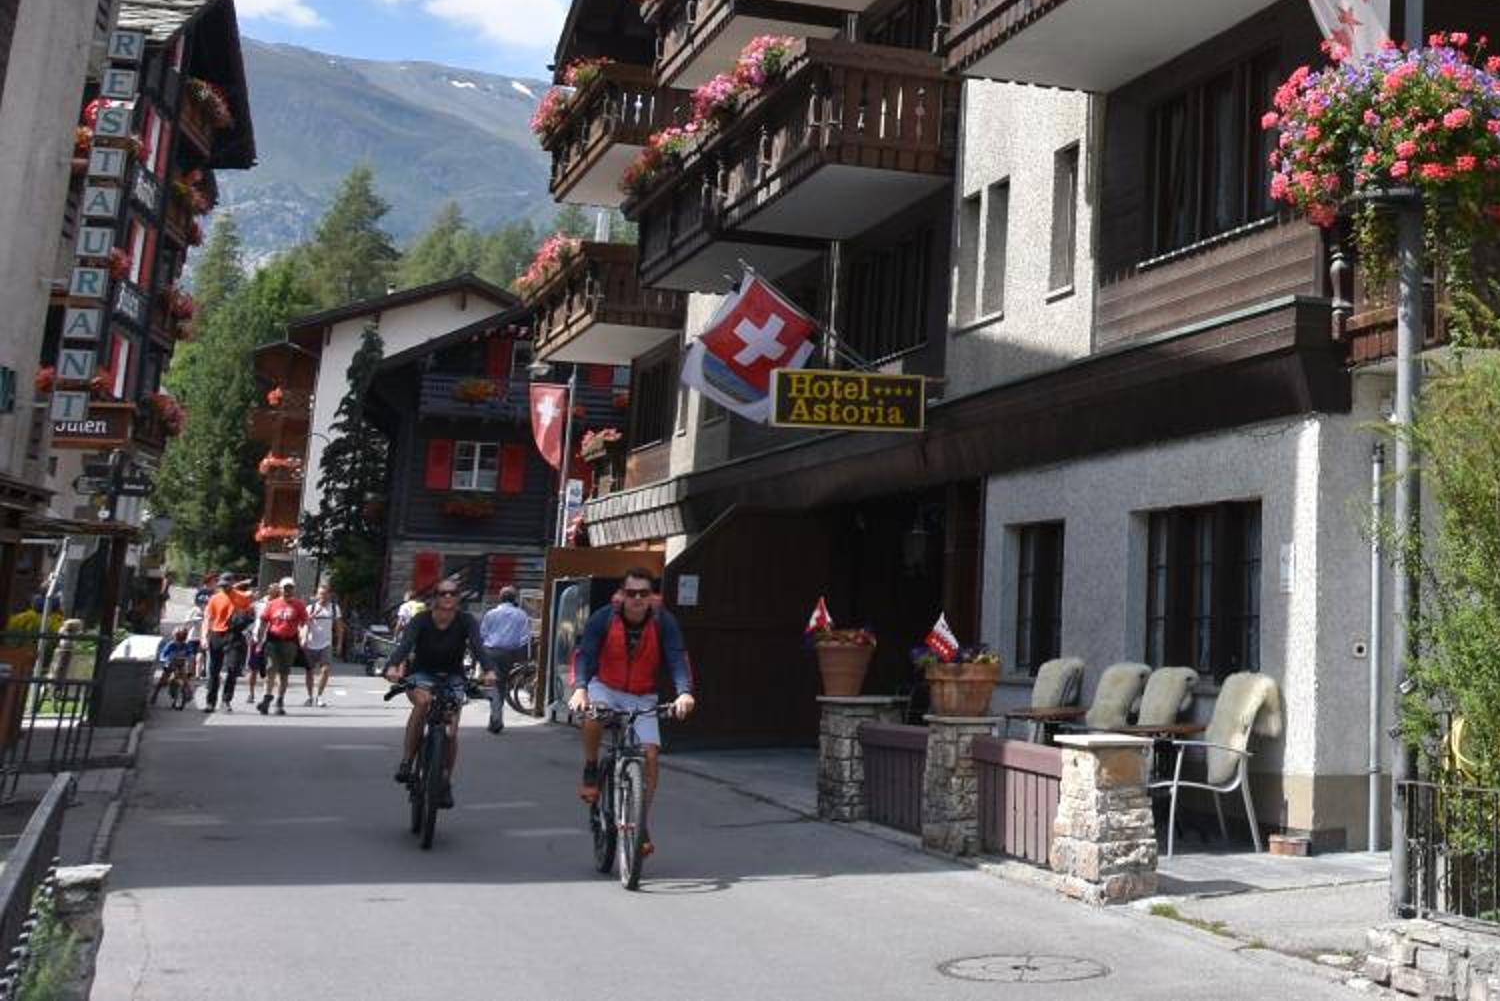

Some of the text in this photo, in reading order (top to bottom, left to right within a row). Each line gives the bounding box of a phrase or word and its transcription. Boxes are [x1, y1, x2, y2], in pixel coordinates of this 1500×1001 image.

[58, 33, 136, 419] RESTAURANT
[788, 374, 870, 400] Hotel
[790, 399, 905, 425] Astoria
